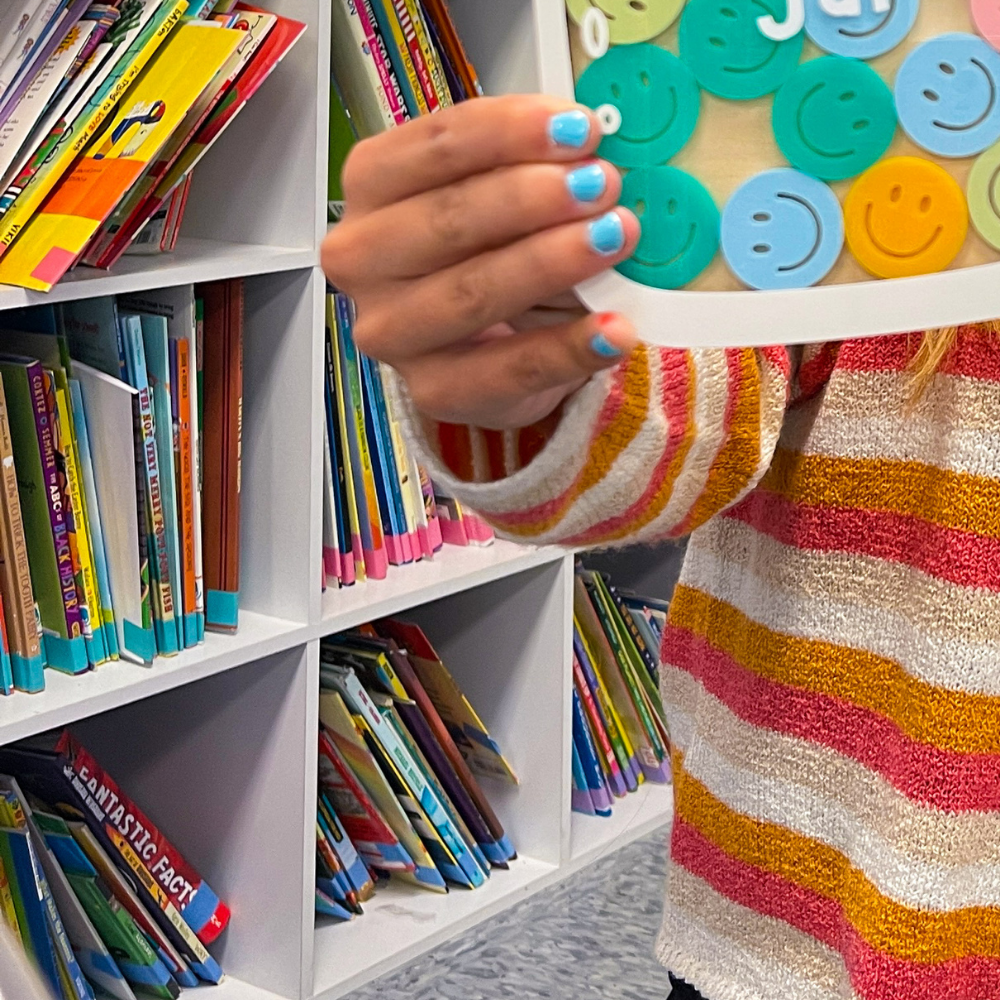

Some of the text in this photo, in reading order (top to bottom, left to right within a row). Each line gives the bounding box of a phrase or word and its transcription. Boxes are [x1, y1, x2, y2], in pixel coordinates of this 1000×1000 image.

[110, 79, 129, 101] Trying
[89, 111, 105, 131] LOVE
[1, 223, 21, 246] VIKI
[33, 375, 45, 414] CORTEZ
[140, 387, 149, 411] THE
[143, 414, 152, 438] NOT
[146, 442, 156, 474] VERY
[6, 474, 16, 497] HOW
[150, 476, 161, 515] MERRY
[10, 502, 19, 516] TO
[12, 517, 25, 549] TRICK
[54, 522, 71, 564] BLACK
[17, 550, 28, 570] THE
[19, 572, 32, 608] TOOTH
[61, 563, 79, 613] HISTORY
[162, 586, 173, 613] FISH
[79, 766, 157, 860] FANTASTIC
